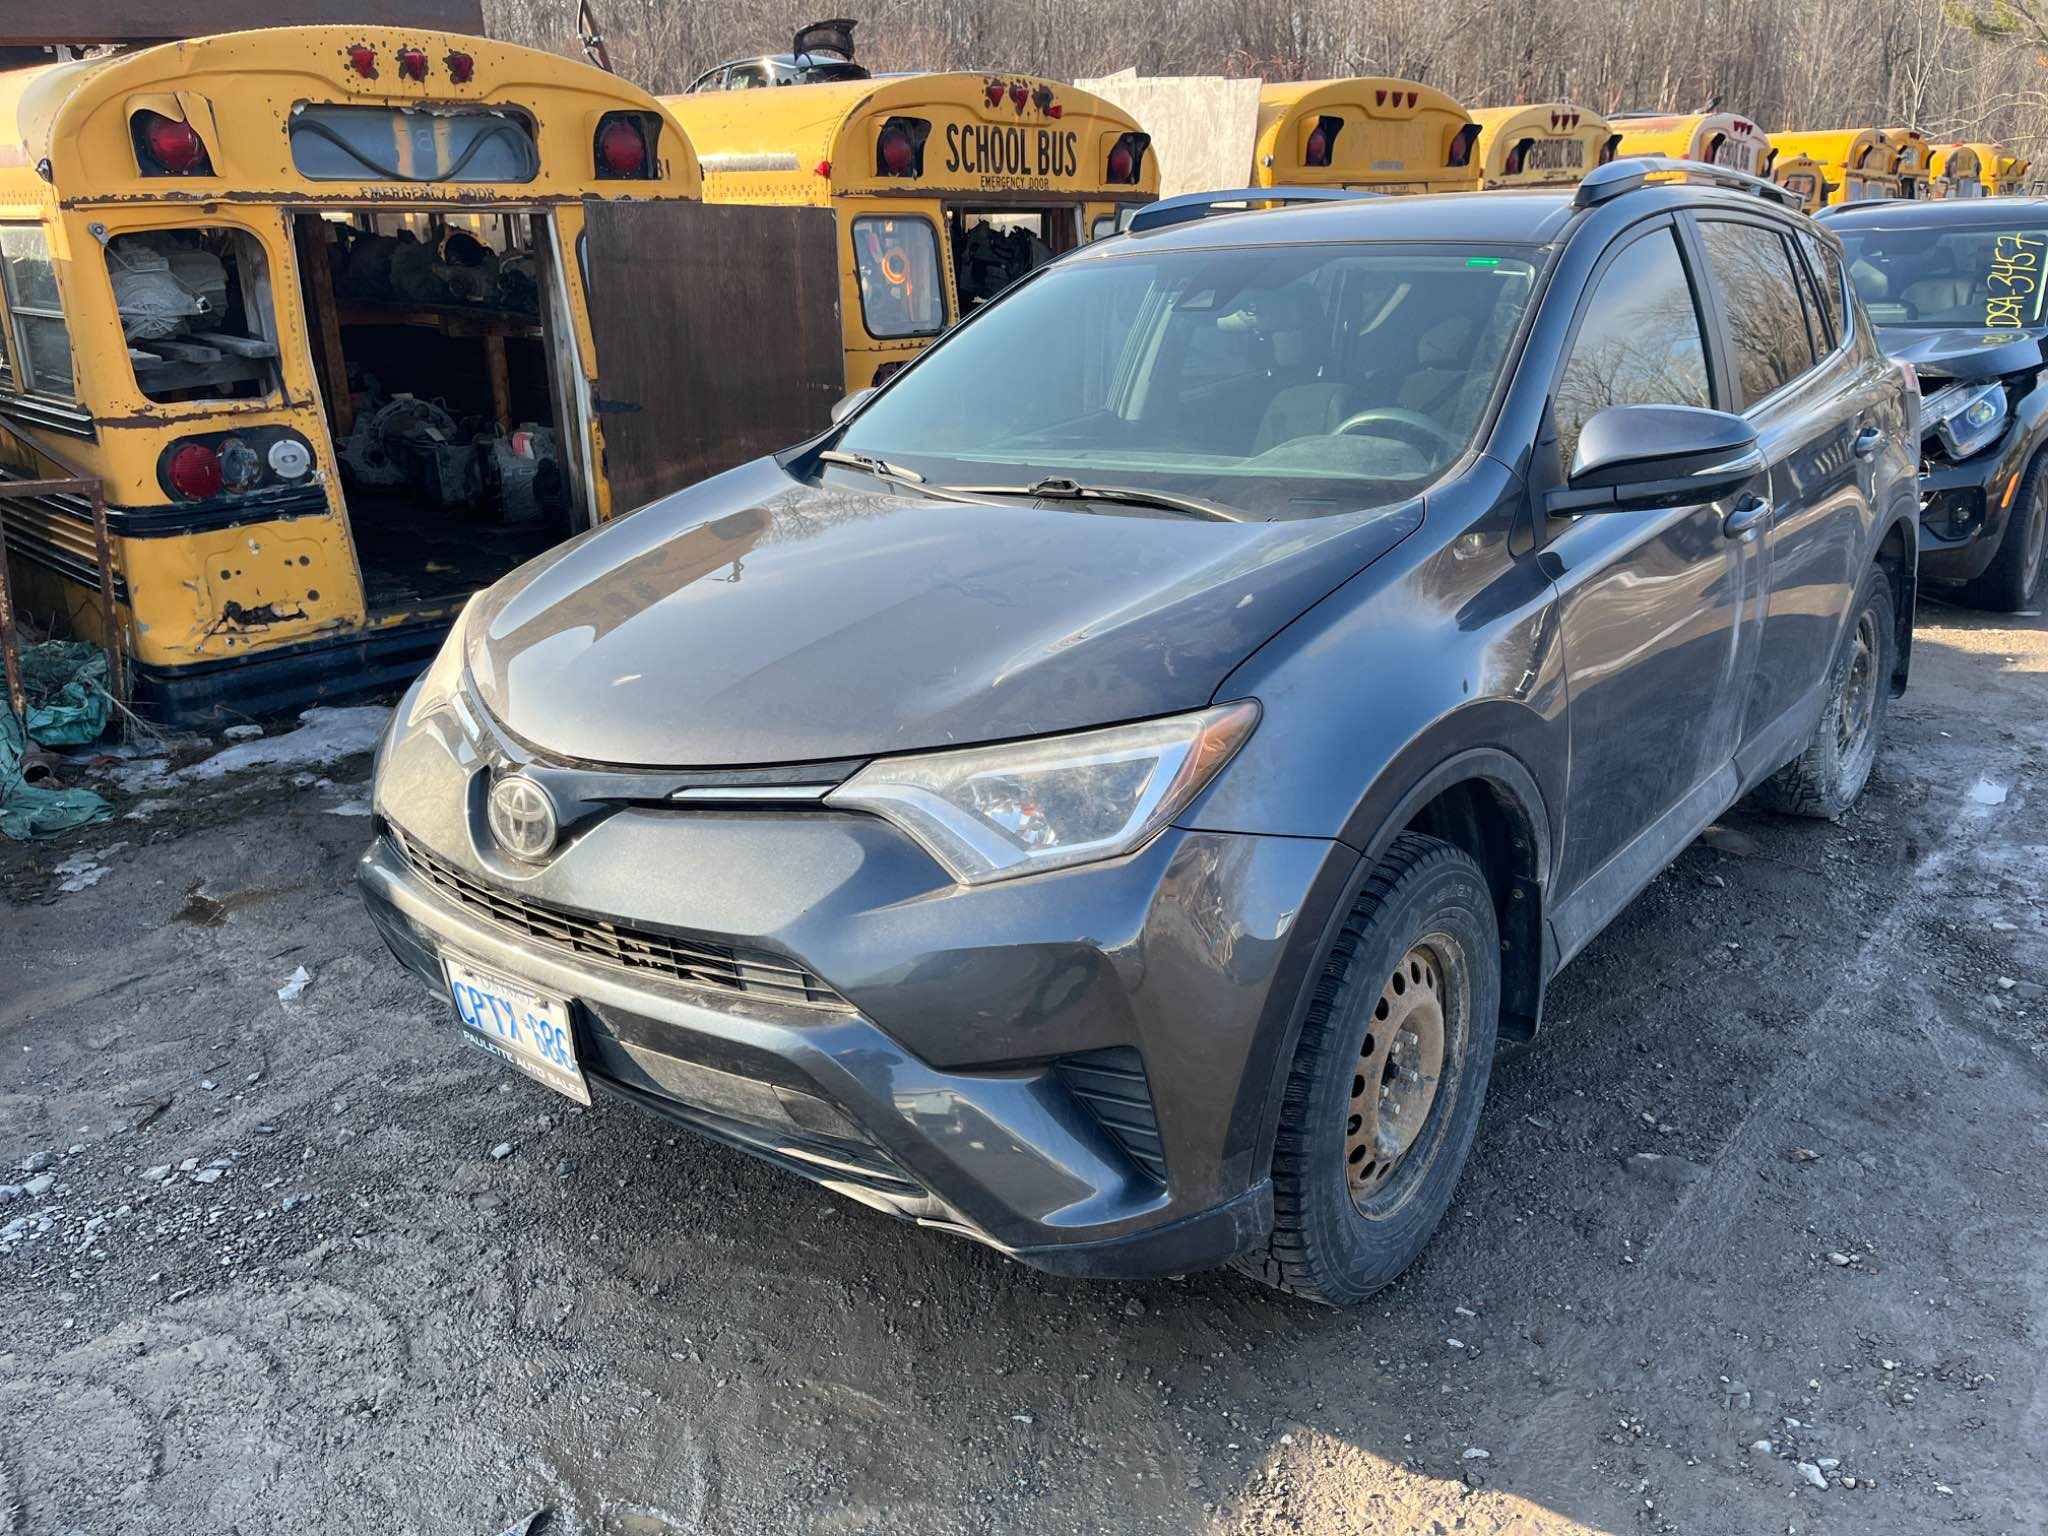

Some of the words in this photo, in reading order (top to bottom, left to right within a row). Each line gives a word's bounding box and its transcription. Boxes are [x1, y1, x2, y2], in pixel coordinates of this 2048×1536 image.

[945, 123, 1031, 175] SCHOOL
[1038, 130, 1077, 177] BUS
[981, 176, 1025, 189] EMERGENCY
[1029, 178, 1049, 190] DOOR
[1985, 232, 2044, 329] DSA-3457
[462, 1030, 515, 1063] PAULETTE
[517, 1057, 545, 1079] AUTO
[547, 1072, 586, 1098] SALES
